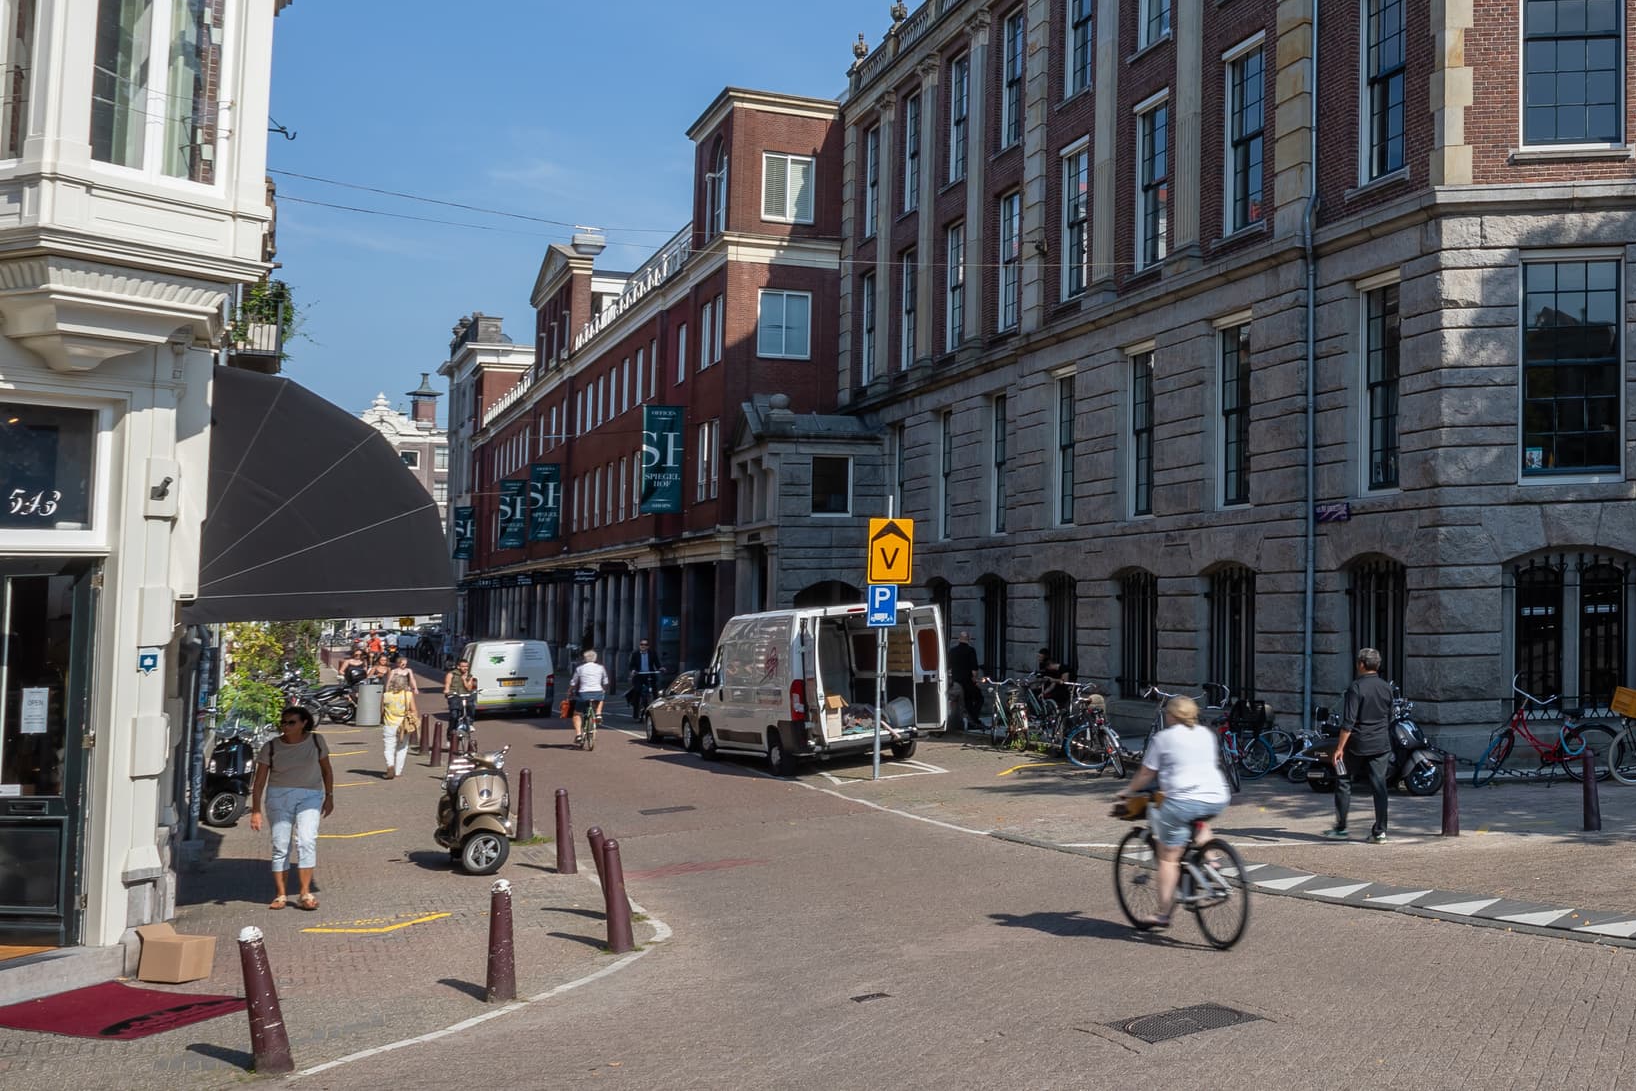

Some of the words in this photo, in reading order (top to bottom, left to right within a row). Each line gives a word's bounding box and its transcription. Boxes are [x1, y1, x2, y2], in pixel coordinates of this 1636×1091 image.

[645, 472, 681, 481] SPIEGEL
[880, 547, 900, 570] V
[875, 587, 891, 609] P
